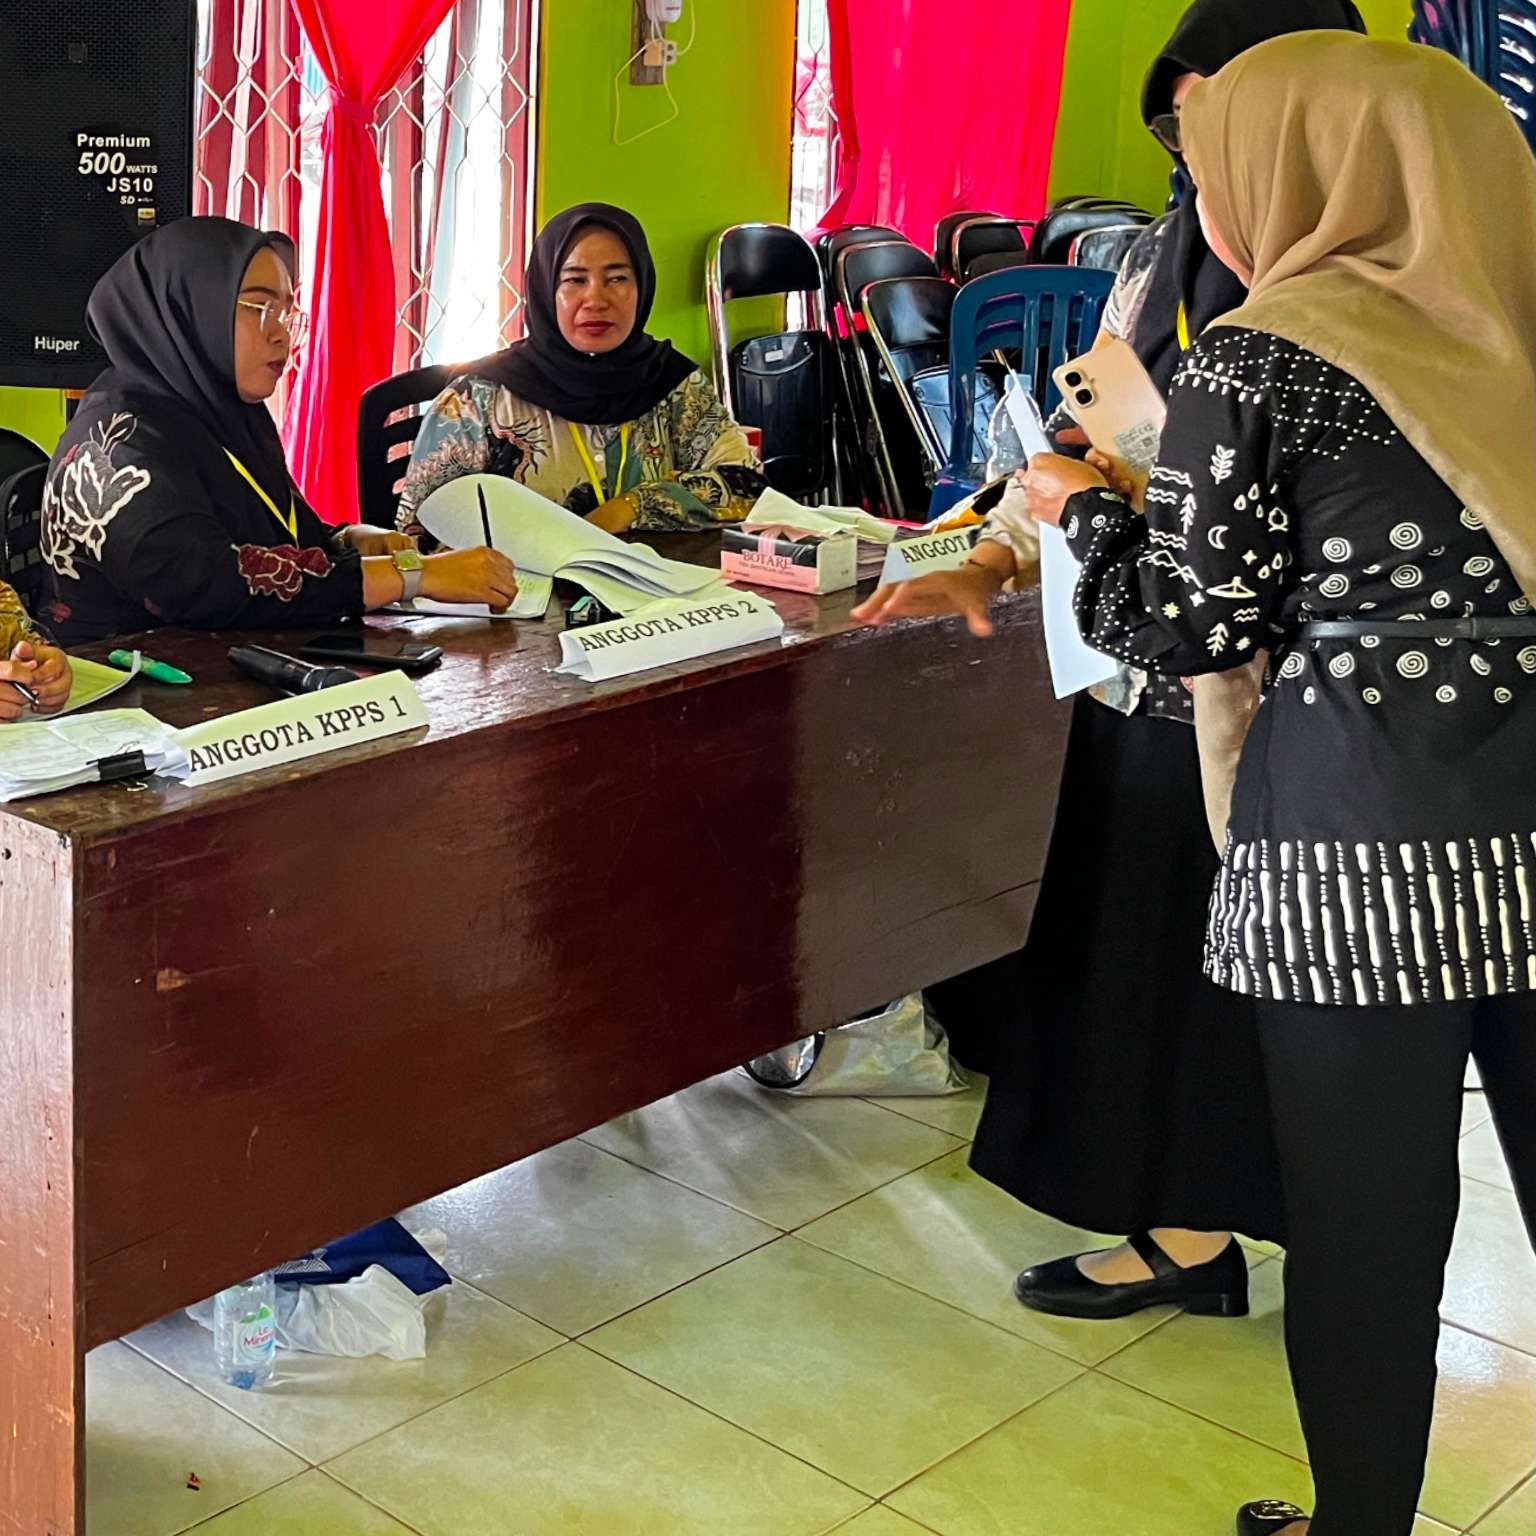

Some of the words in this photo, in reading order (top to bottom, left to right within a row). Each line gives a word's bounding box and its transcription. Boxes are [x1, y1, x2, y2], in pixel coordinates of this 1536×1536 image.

[76, 133, 151, 148] Premium
[78, 152, 126, 175] 500
[126, 165, 159, 174] WATTS
[106, 178, 154, 193] JS10
[34, 335, 80, 354] Hüper
[900, 533, 970, 564] ANGGOT
[578, 616, 684, 652] ANGGOTA
[677, 603, 739, 628] KPPS
[737, 599, 758, 615] 2
[189, 721, 315, 773] ANGGOTA
[314, 700, 385, 737] KPPS
[388, 695, 407, 717] 1
